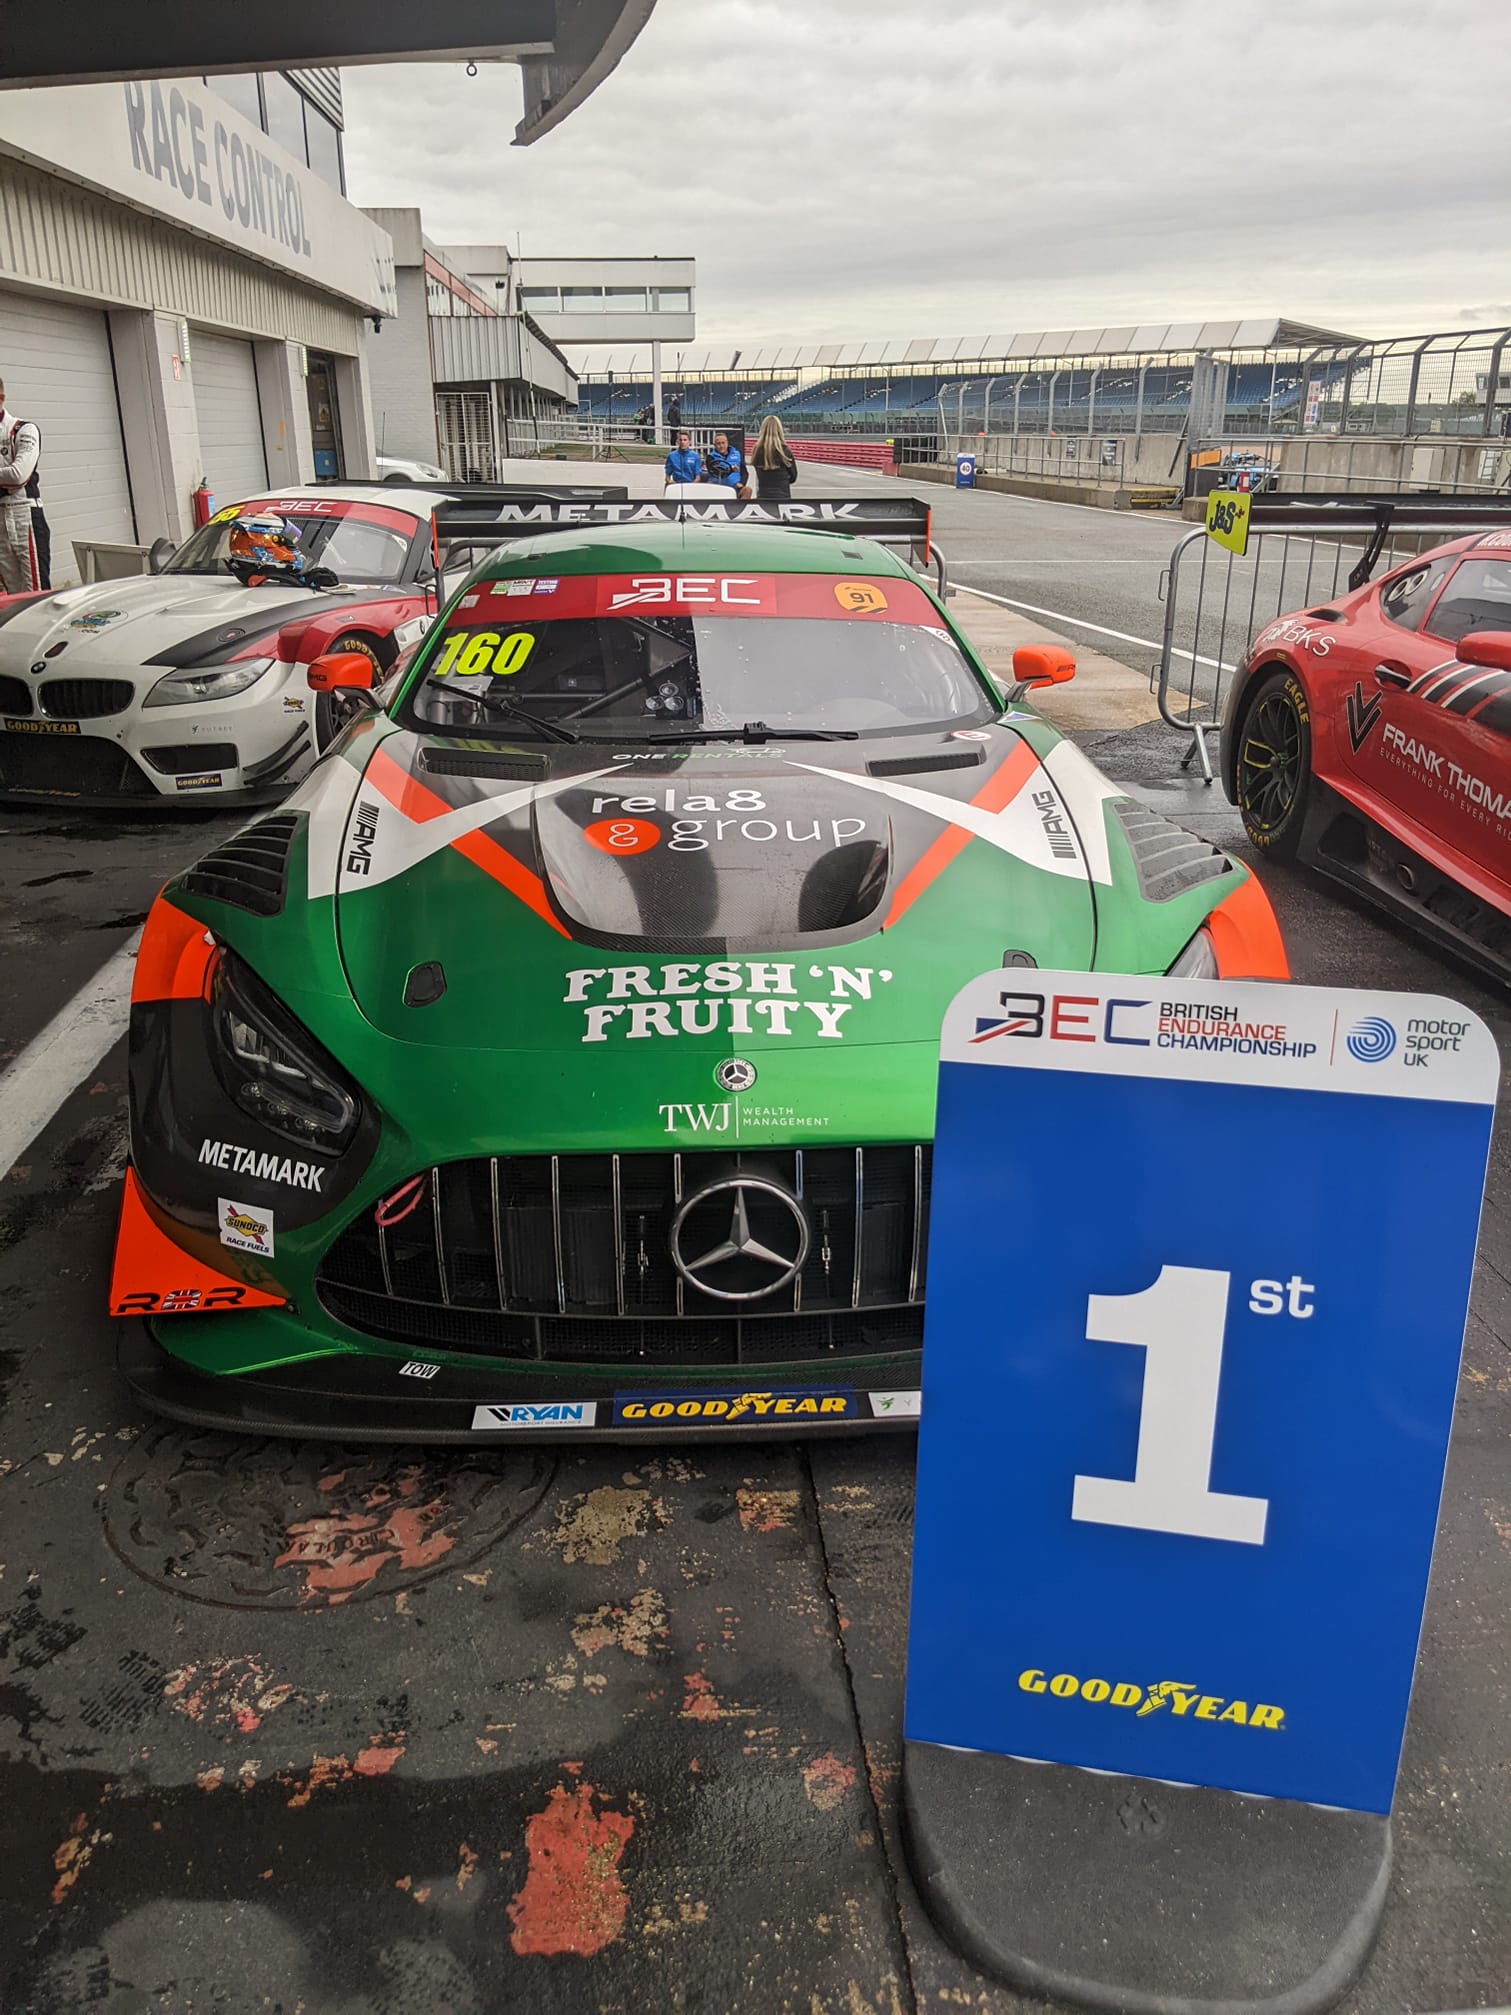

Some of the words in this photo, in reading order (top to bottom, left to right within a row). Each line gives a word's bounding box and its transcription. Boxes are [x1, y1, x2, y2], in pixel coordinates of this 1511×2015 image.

[124, 81, 212, 207] RACE
[214, 120, 312, 258] CONTROL
[495, 503, 864, 522] METAMARK
[1208, 500, 1237, 535] J&S
[607, 578, 761, 610] BEC
[850, 592, 875, 604] 91
[435, 631, 536, 676] 160
[1283, 625, 1337, 657] BKS
[1283, 676, 1311, 725] EAGLE
[6, 721, 78, 734] GOODYEAR
[612, 753, 667, 761] ONE
[1381, 722, 1446, 779] FRANK
[1380, 746, 1434, 788] EVERYTHING
[1437, 784, 1456, 802] FOR
[1460, 799, 1491, 826] EVERY
[591, 788, 767, 814] rela8
[1031, 790, 1072, 843] AMG
[345, 812, 380, 875] AMG
[666, 817, 867, 852] group
[563, 961, 799, 1003] FRESH
[581, 998, 854, 1043] FRUITY
[968, 991, 1153, 1044] BEC
[1159, 1002, 1239, 1022] BRITISH
[1157, 1017, 1288, 1042] ENDURANCE
[1407, 1018, 1472, 1037] motor
[1156, 1033, 1318, 1059] CHAMPIONSHIP
[1404, 1034, 1463, 1052] sport
[1403, 1052, 1430, 1068] UK
[658, 1103, 733, 1133] TWJ
[742, 1106, 794, 1116] WEALTH
[742, 1117, 830, 1127] MANAGEMENT
[198, 1138, 326, 1193] METAMARK
[227, 1216, 267, 1234] SUNOCO
[226, 1236, 247, 1248] RACE
[247, 1242, 270, 1253] FUELS
[403, 1362, 439, 1377] TOW
[510, 1404, 584, 1421] RYAN
[622, 1393, 846, 1420] GOODYEAR
[1018, 1669, 1285, 1730] GOODYEAR
